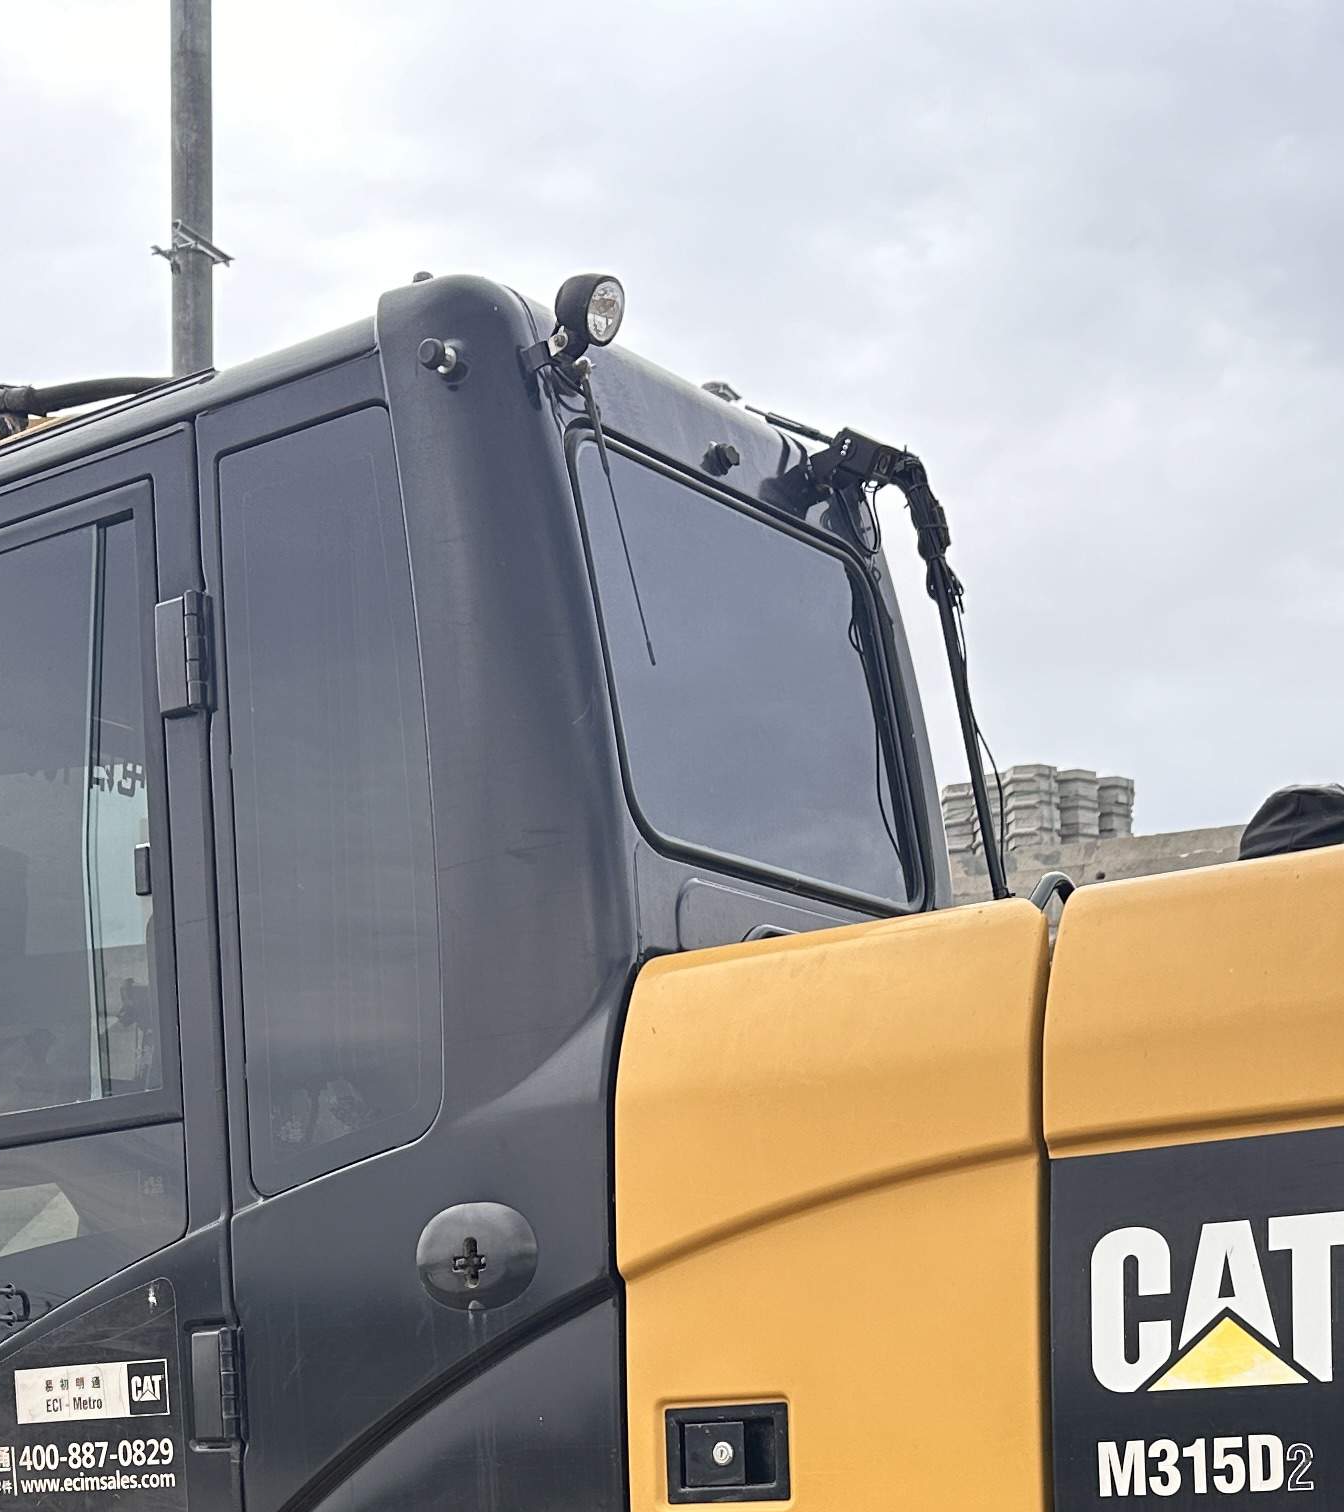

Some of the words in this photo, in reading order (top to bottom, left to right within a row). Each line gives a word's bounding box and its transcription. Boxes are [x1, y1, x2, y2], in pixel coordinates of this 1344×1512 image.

[45, 1376, 101, 1393] 易初明通
[130, 1374, 163, 1402] CAT
[46, 1398, 63, 1413] ECI
[73, 1396, 103, 1411] Metro
[19, 1438, 174, 1471] 400-887-0829
[1097, 1433, 1315, 1498] M315D2
[21, 1469, 176, 1494] www.ecimsales.com
